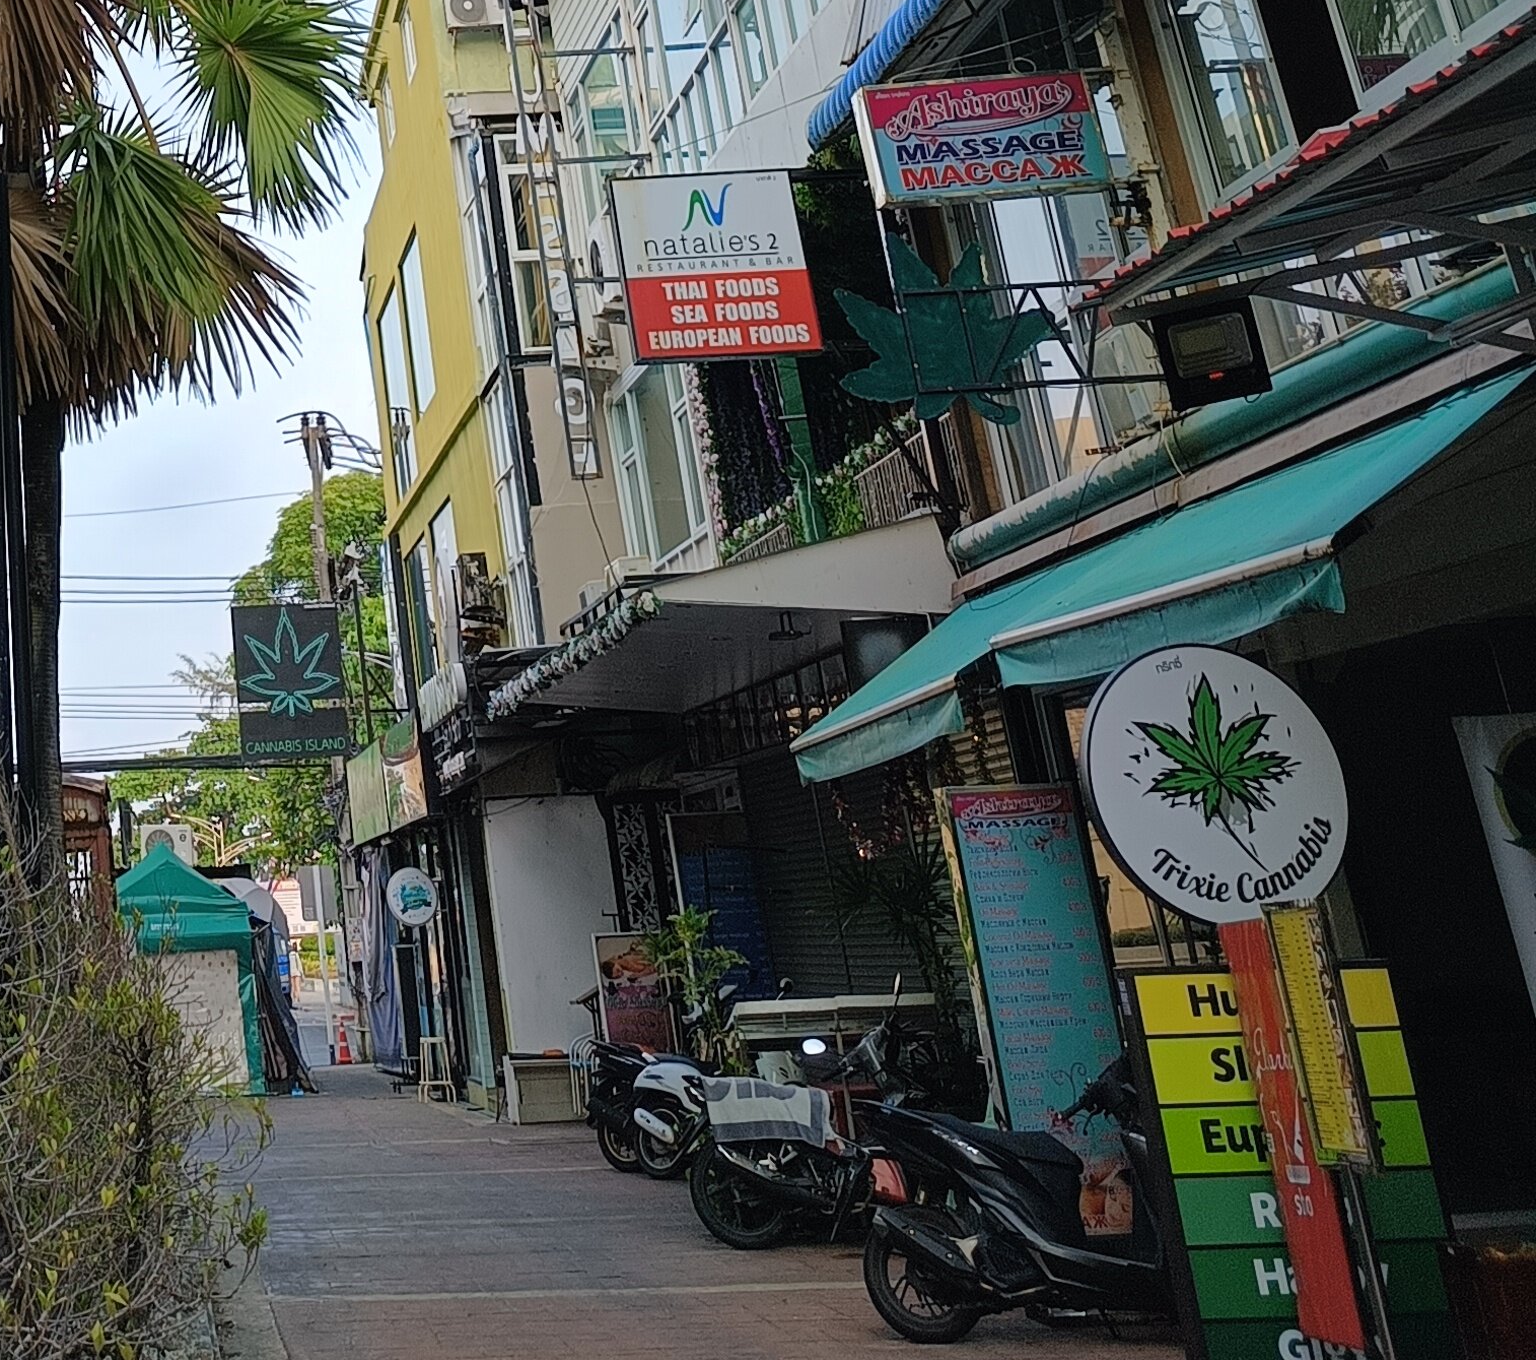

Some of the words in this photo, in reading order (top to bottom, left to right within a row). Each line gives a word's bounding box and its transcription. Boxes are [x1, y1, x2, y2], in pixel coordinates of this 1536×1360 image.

[886, 79, 1072, 141] Ashiraya
[896, 130, 1084, 164] MASSAGE
[901, 153, 1091, 191] МАССАЖ
[643, 231, 760, 257] natalie's
[766, 233, 779, 250] 2
[637, 259, 739, 273] RESTAURANT
[748, 257, 757, 267] &
[765, 256, 794, 266] BAR
[661, 280, 709, 301] THAI
[714, 276, 780, 298] FOODS
[670, 304, 709, 325] SEA
[714, 300, 780, 322] FOODS
[648, 327, 743, 350] EUROPEAN
[748, 323, 811, 345] FOODS
[245, 739, 302, 755] CANNABIS
[305, 736, 346, 751] ISLAND
[1151, 848, 1232, 902] Trixie
[1236, 815, 1333, 903] Cannabis
